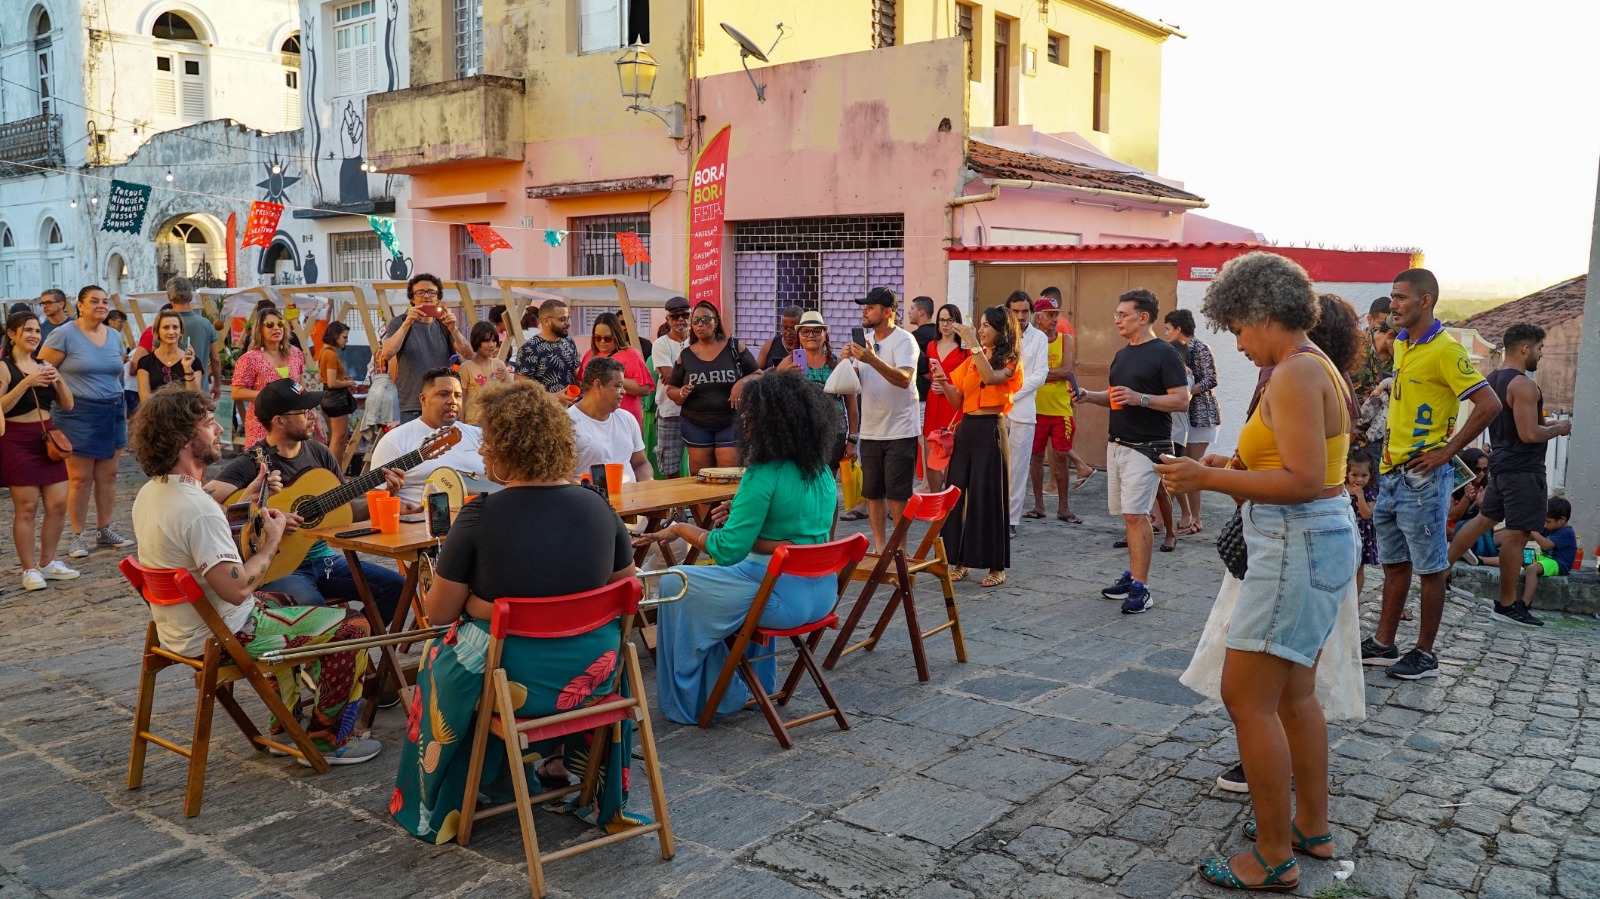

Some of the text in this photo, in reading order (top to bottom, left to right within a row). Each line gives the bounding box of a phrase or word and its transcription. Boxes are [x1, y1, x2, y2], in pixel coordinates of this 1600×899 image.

[694, 164, 725, 187] BORA
[114, 186, 143, 197] PORQUE
[111, 194, 145, 205] NINGUÉM
[109, 203, 144, 213] VAI DORMIR
[110, 212, 138, 220] NOSSOS
[106, 219, 135, 228] SONHOS
[689, 369, 737, 386] PARIS
